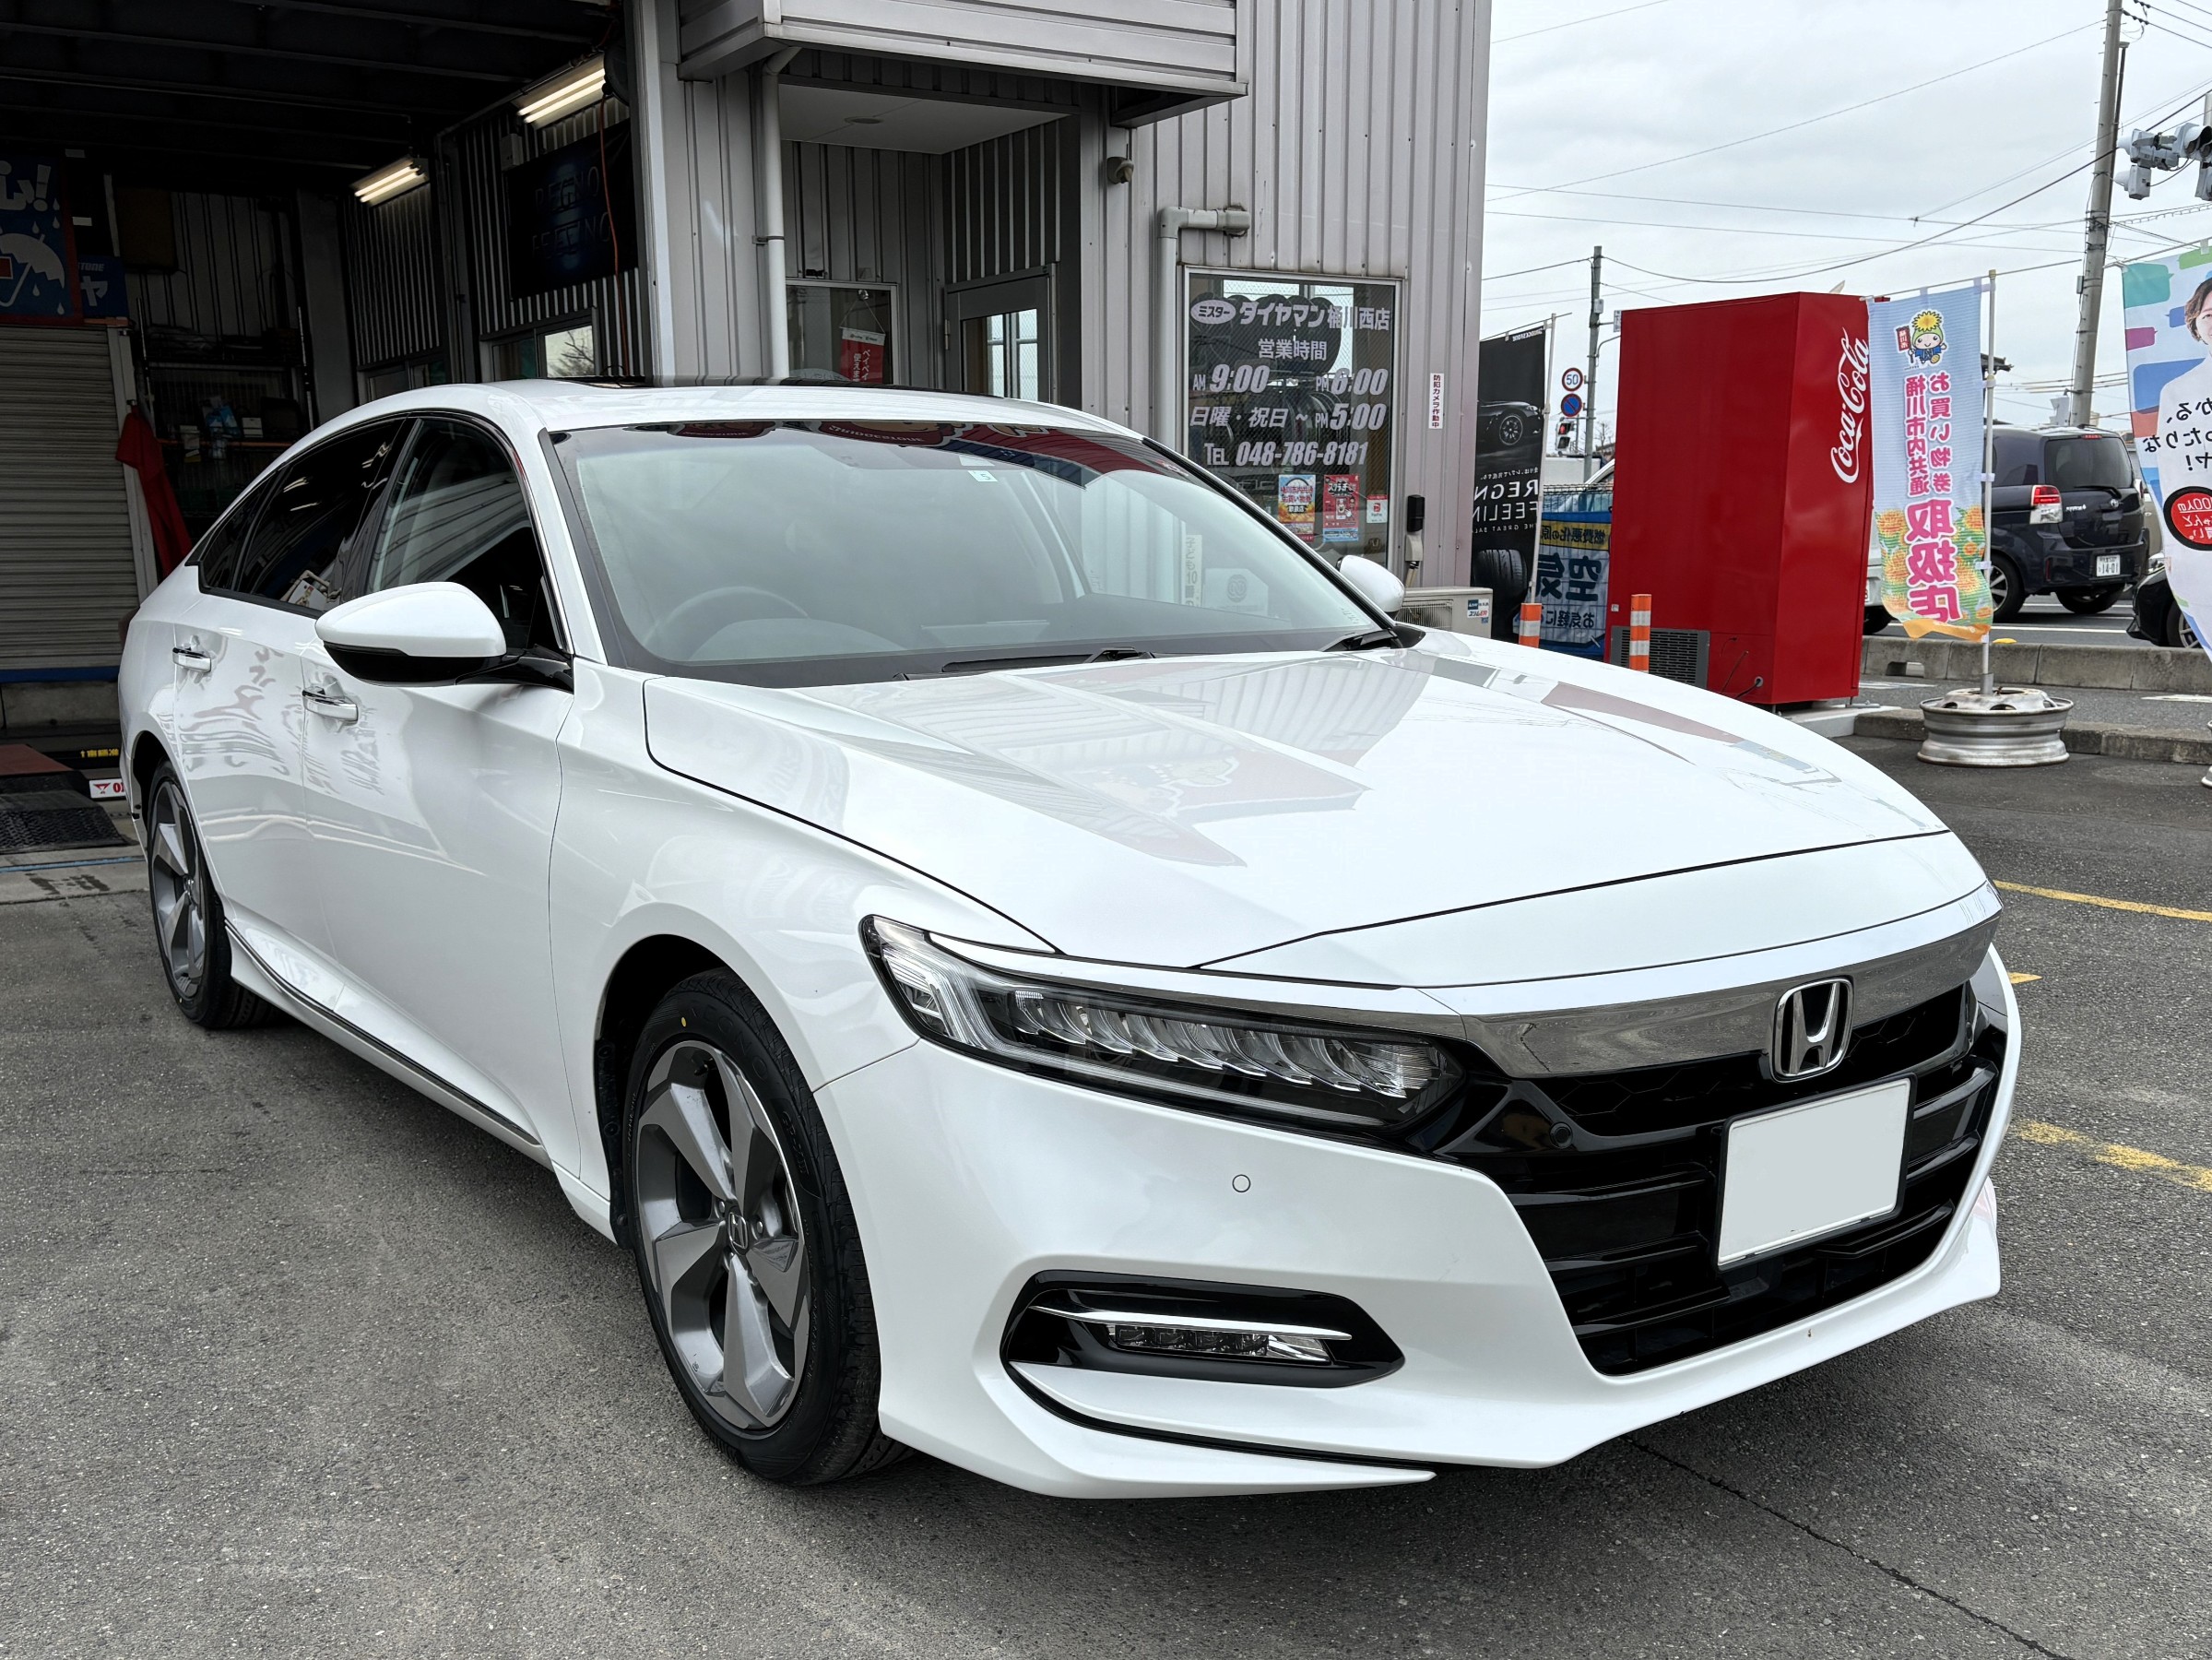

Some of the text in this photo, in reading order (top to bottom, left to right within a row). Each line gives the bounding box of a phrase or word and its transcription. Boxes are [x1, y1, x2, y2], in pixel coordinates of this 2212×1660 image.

[77, 261, 105, 272] TONE
[1199, 305, 1231, 318] ミスター
[1258, 338, 1328, 361] 営業時間
[1193, 374, 1206, 391] AM
[1210, 364, 1271, 394] 9:00
[1316, 376, 1329, 392] PM
[1331, 368, 1389, 396] 6:00
[1567, 374, 1579, 385] 50
[1316, 413, 1329, 429] PM
[1330, 403, 1388, 431] 5:00
[1830, 326, 1870, 484] Coca-Cola
[1236, 441, 1368, 467] 048-786-8181
